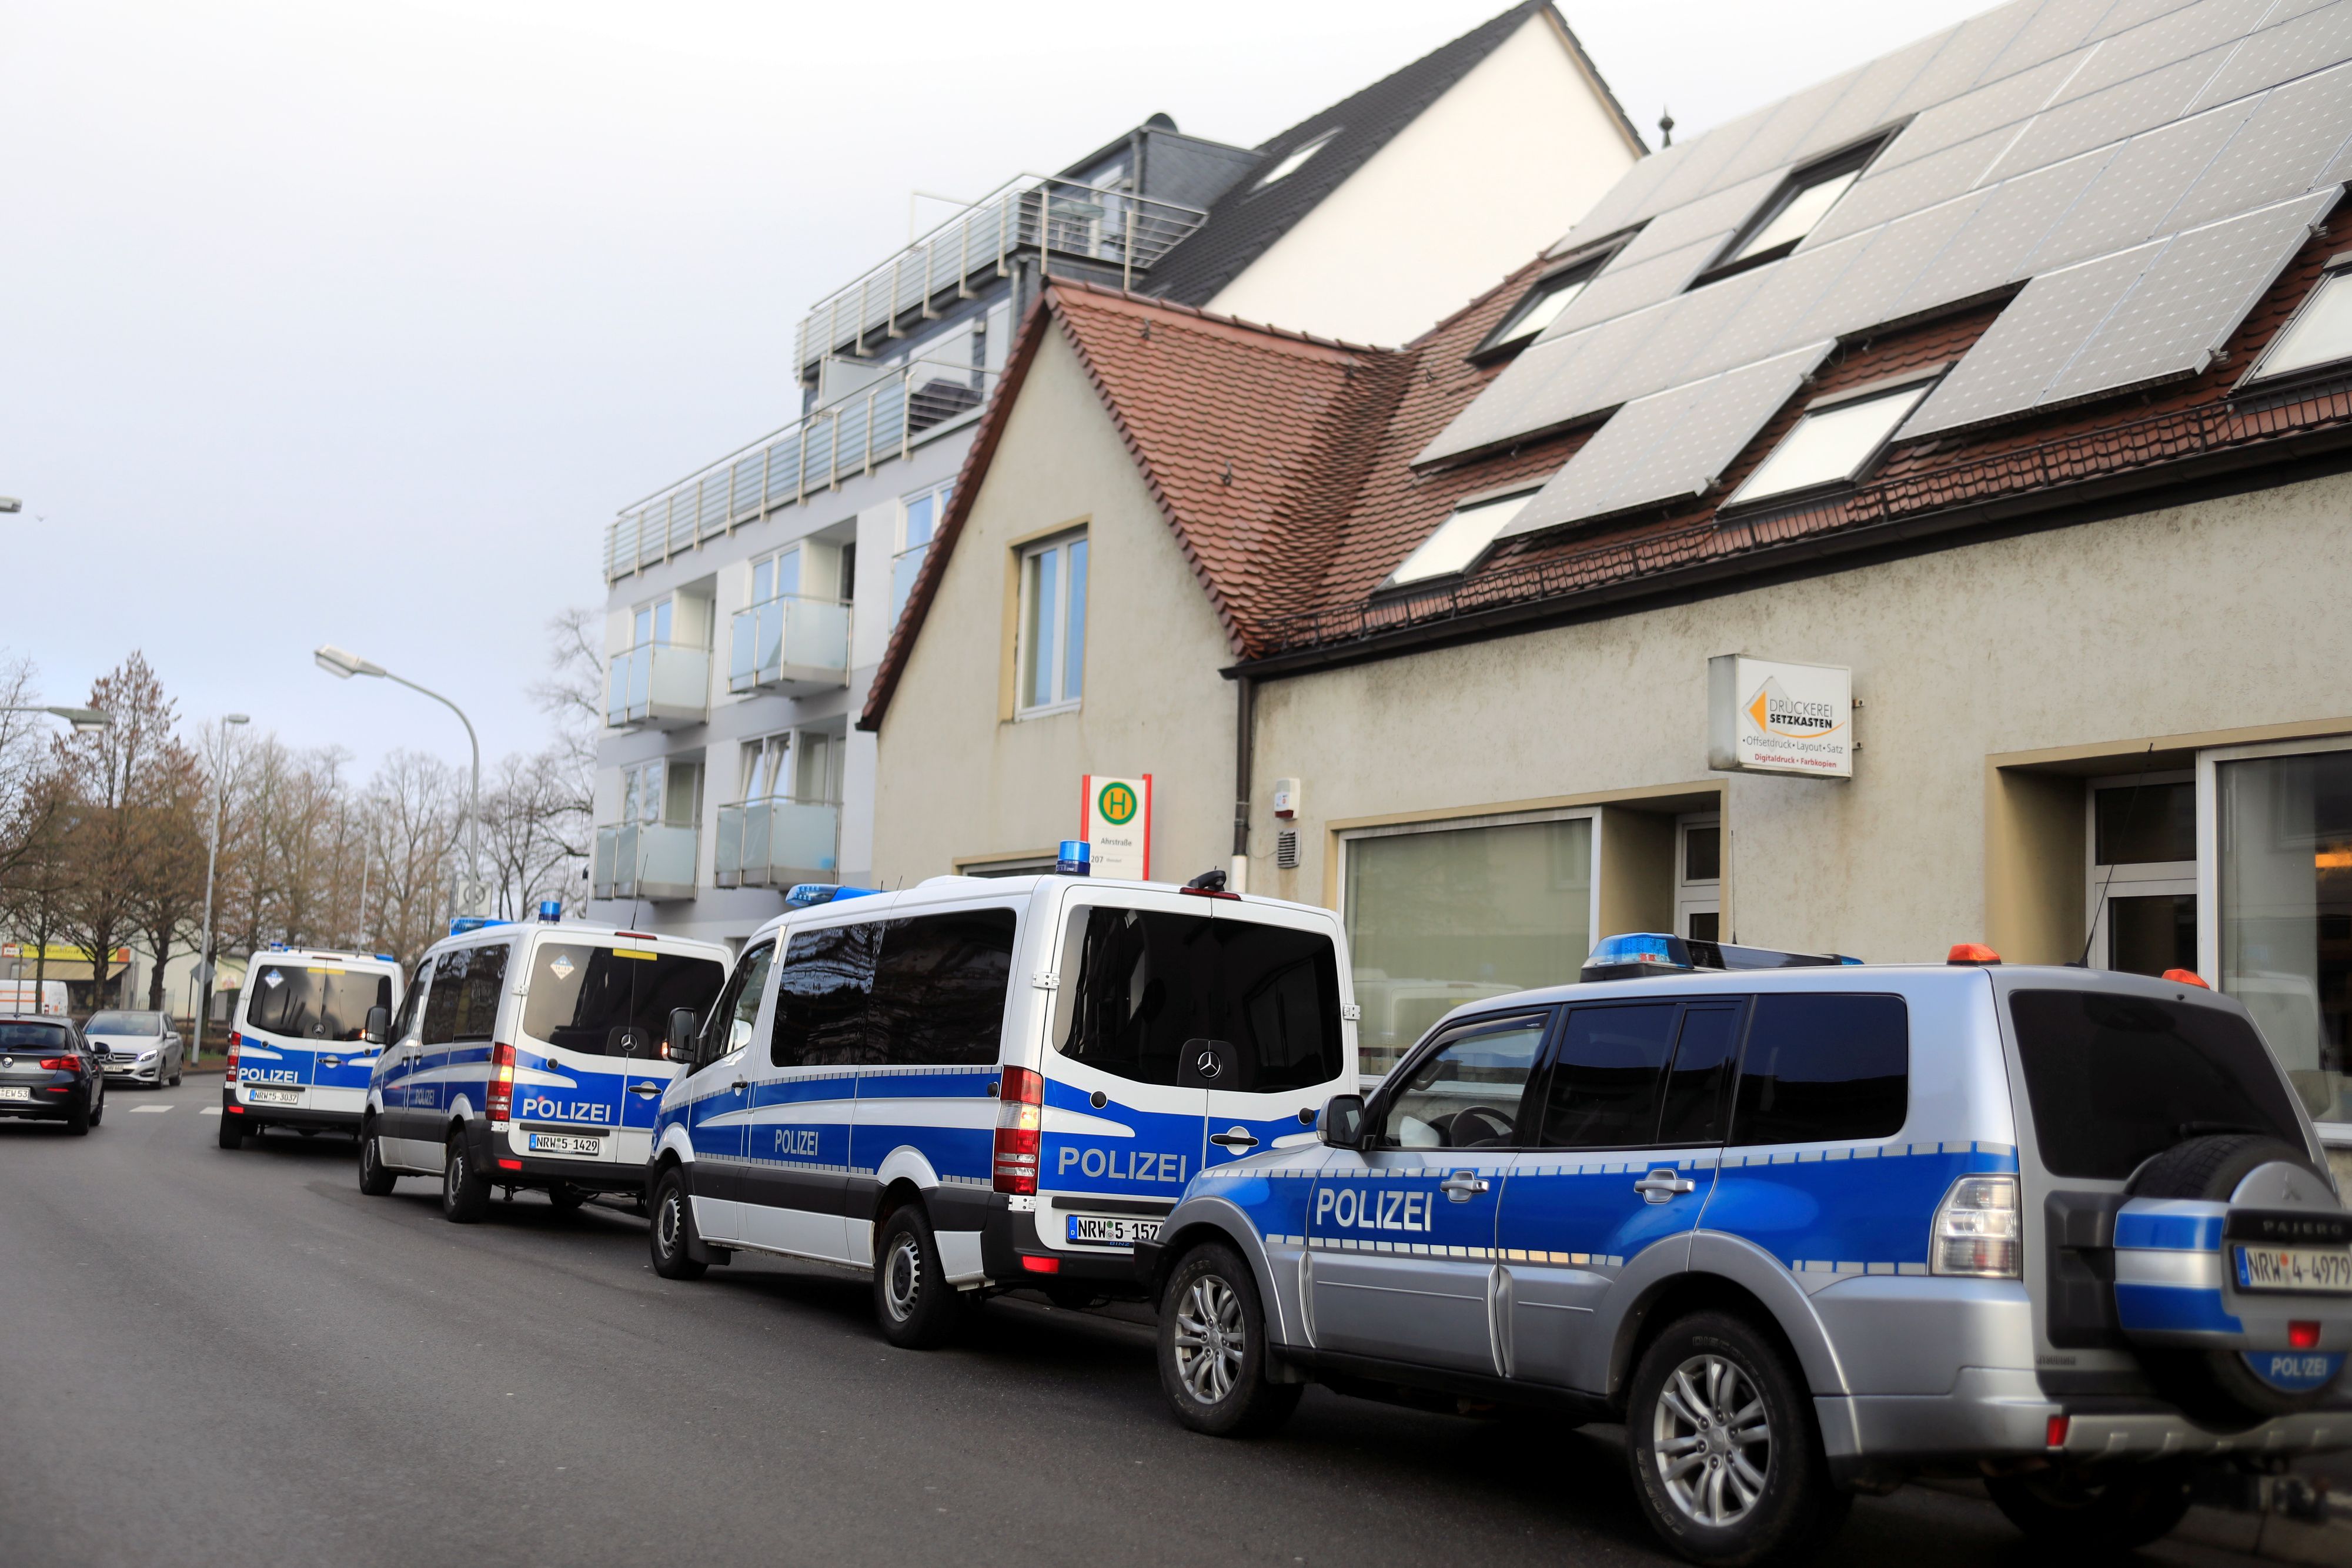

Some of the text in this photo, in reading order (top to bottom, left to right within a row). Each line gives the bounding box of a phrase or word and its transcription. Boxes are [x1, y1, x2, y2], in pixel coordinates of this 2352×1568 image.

[1769, 713, 1833, 729] SETZKASTEN
[1754, 753, 1837, 768] Digitaldruck Farbkopien
[1110, 791, 1126, 816] H
[1100, 837, 1132, 847] Ahrstraße
[238, 1067, 299, 1084] POLIZEI
[5, 1089, 16, 1098] EW
[255, 1091, 268, 1099] NRW
[415, 1088, 435, 1106] POLIZEI
[522, 1098, 611, 1122] POLIZEI
[536, 1136, 556, 1148] NRW
[774, 1129, 818, 1156] POLIZEI
[1058, 1146, 1187, 1183] POLIZEI
[1316, 1188, 1434, 1232] POLIZEI
[1078, 1219, 1106, 1239] NRW
[2263, 1221, 2343, 1235] PAJERO
[2247, 1251, 2281, 1283] NRW
[2271, 1357, 2328, 1376] POLIZEI
